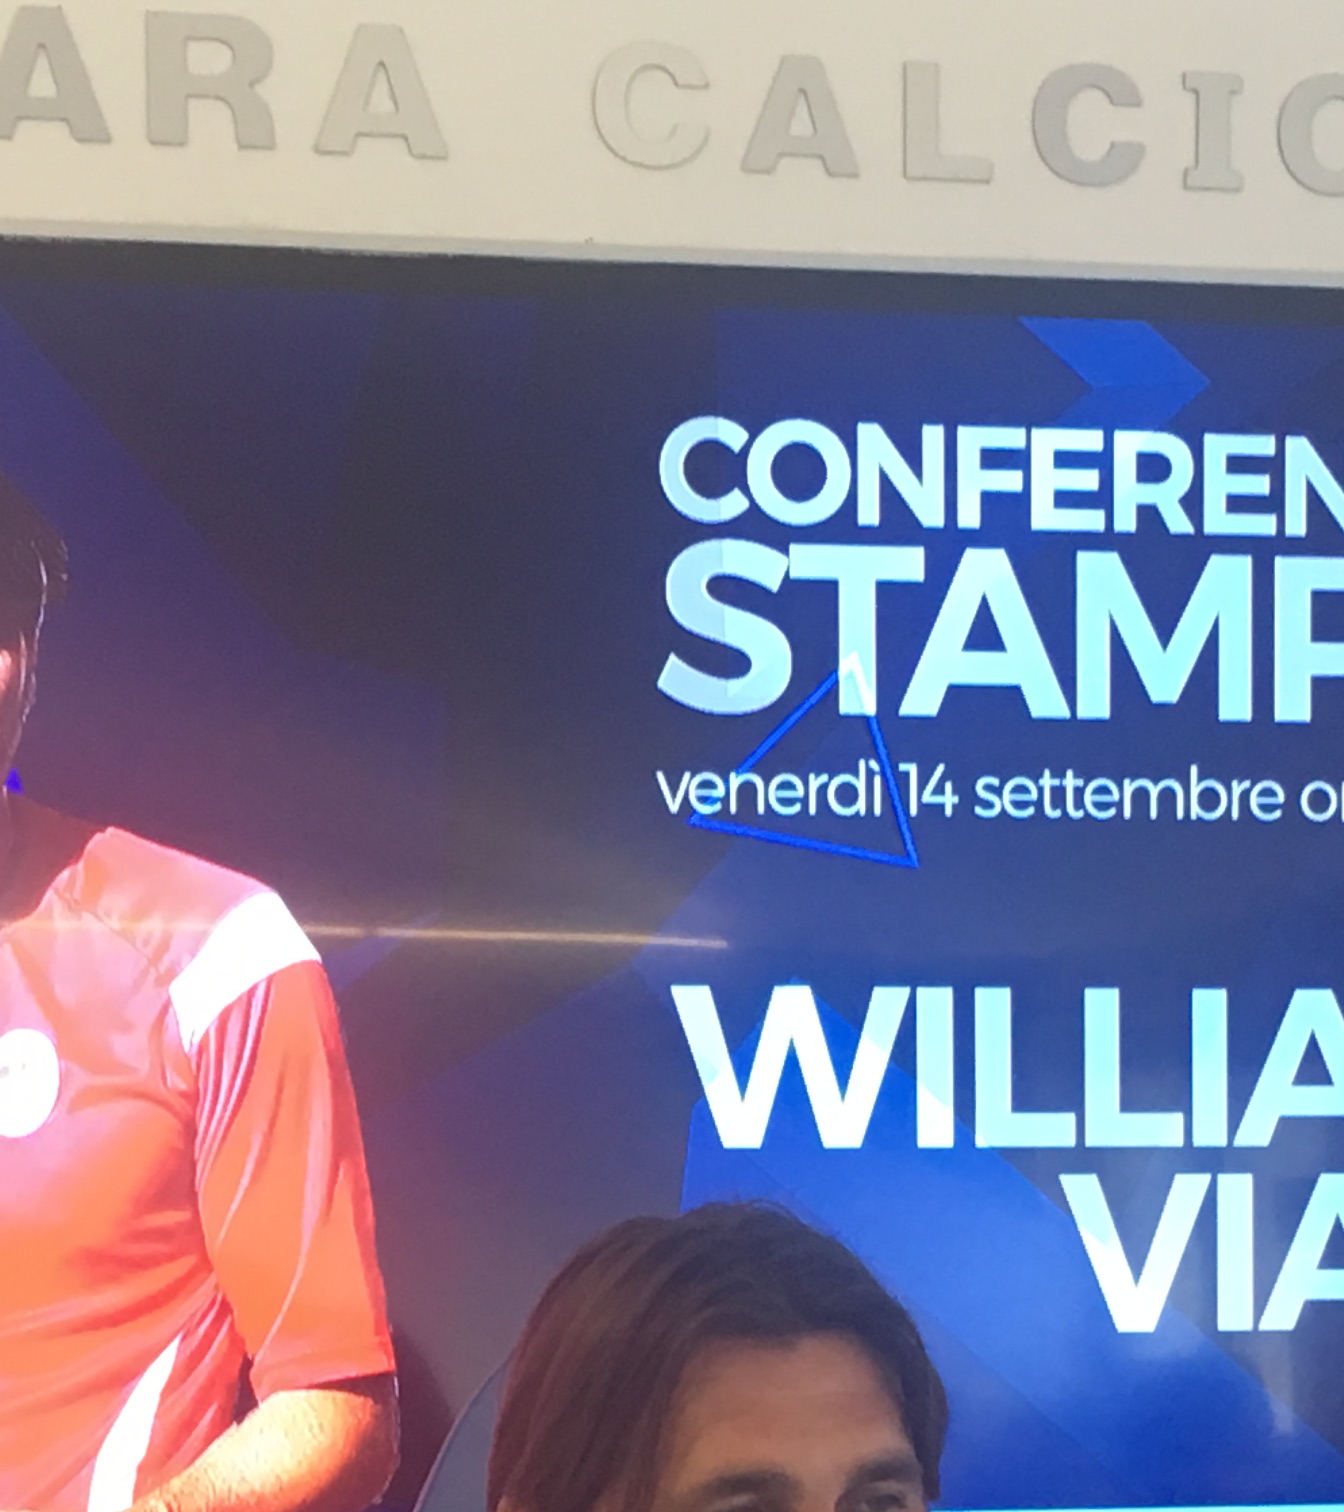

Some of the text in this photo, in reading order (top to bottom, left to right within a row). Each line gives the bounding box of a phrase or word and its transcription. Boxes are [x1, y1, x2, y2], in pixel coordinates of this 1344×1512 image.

[656, 760, 884, 818] venerdì
[903, 763, 955, 820] 14
[973, 764, 1285, 822] settembre
